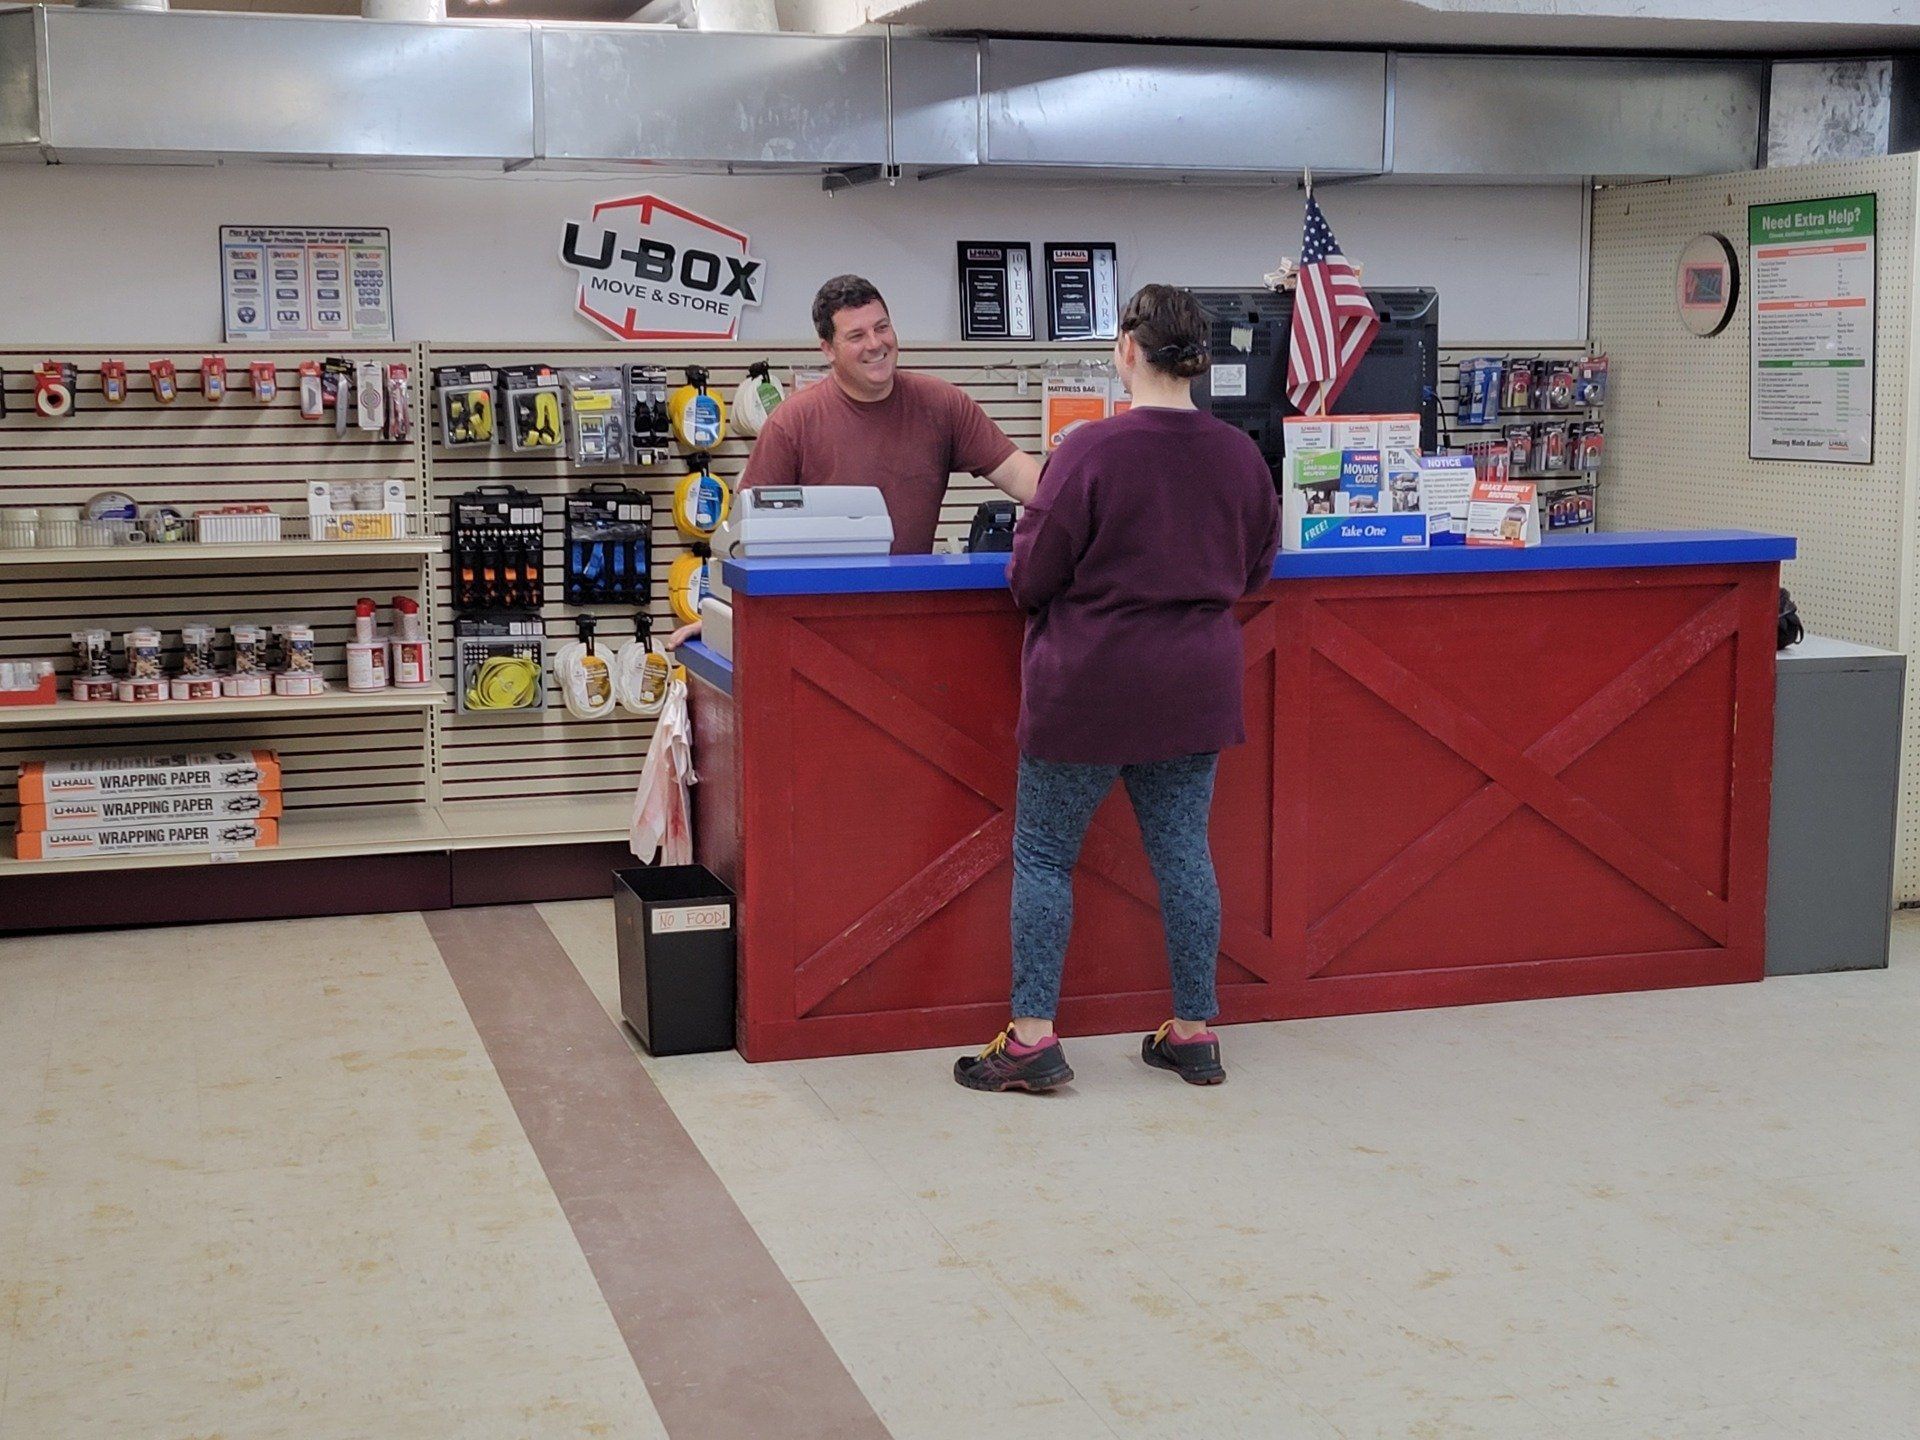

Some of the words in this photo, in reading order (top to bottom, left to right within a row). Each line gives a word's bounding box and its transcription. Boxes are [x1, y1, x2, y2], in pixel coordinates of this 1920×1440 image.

[1762, 214, 1791, 230] Need
[1794, 213, 1825, 227] Extra
[1828, 207, 1861, 225] Help?
[562, 222, 761, 302] U-BOX
[1011, 253, 1023, 263] 10
[1099, 254, 1107, 267] 5
[590, 276, 647, 300] MOVE
[651, 289, 664, 303] &
[667, 292, 730, 316] STORE
[1013, 266, 1024, 331] YEARS
[1099, 272, 1110, 330] YEARS
[1343, 464, 1378, 474] MOVING
[1427, 459, 1462, 468] NOTICE
[1355, 475, 1378, 483] GUIDE
[1479, 483, 1502, 491] MAKE
[1304, 520, 1329, 541] FREE!
[1341, 525, 1363, 537] Take
[1364, 525, 1387, 537] One
[51, 778, 95, 787] U-HAUL
[100, 773, 167, 789] WRAPPING
[171, 771, 211, 785] PAPER
[54, 806, 98, 815] U-HAUL
[102, 800, 170, 816] WRAPPING
[173, 798, 213, 813] PAPER
[50, 834, 93, 843] U-HAUL
[98, 829, 165, 845] WRAPPING
[169, 827, 209, 841] PAPER
[660, 914, 675, 927] NO
[686, 909, 727, 926] FOOD!
